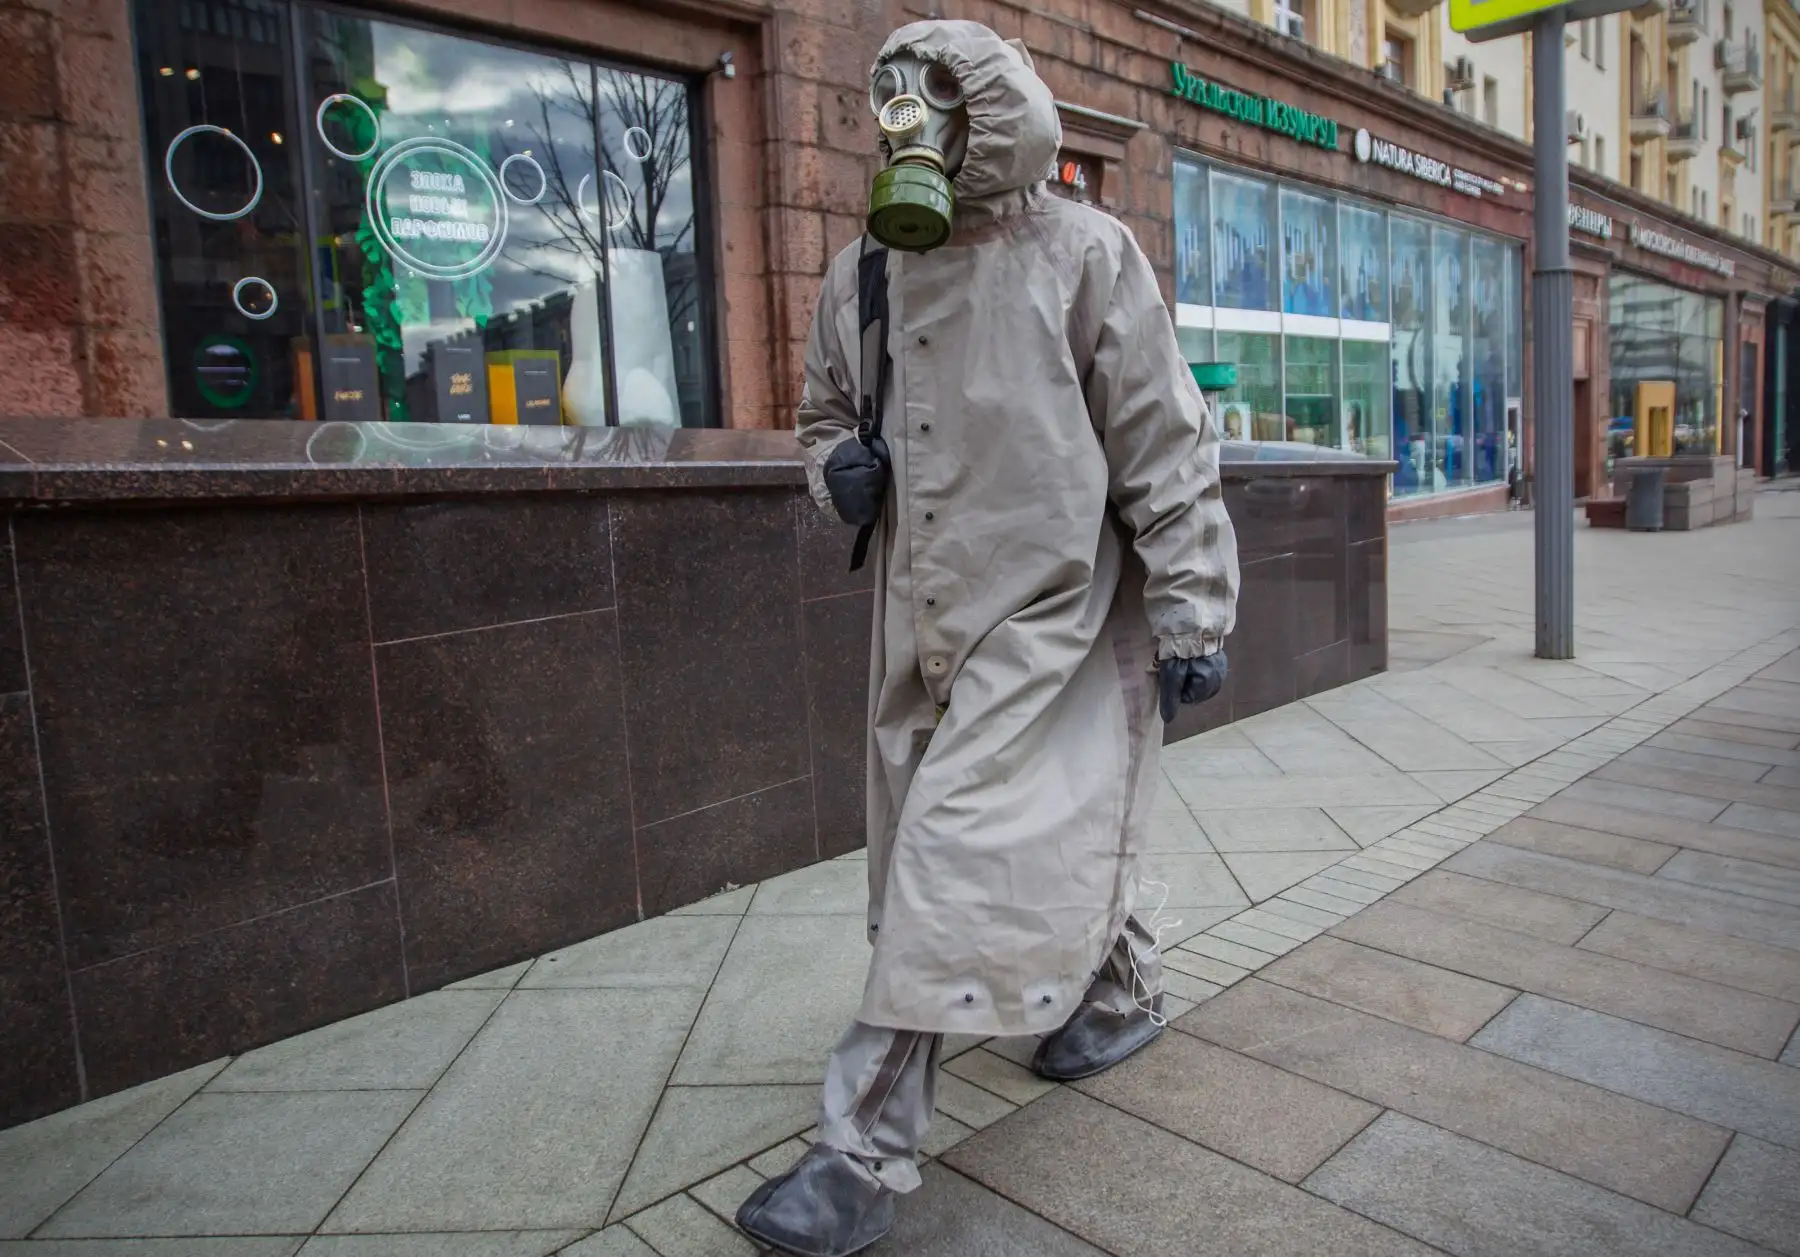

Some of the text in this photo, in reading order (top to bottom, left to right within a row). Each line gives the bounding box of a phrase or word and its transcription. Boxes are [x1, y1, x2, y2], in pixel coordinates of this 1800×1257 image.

[1373, 138, 1415, 173] NATURA
[1415, 153, 1452, 188] SIBERICA
[390, 217, 490, 241] ПАРФЮМОВ
